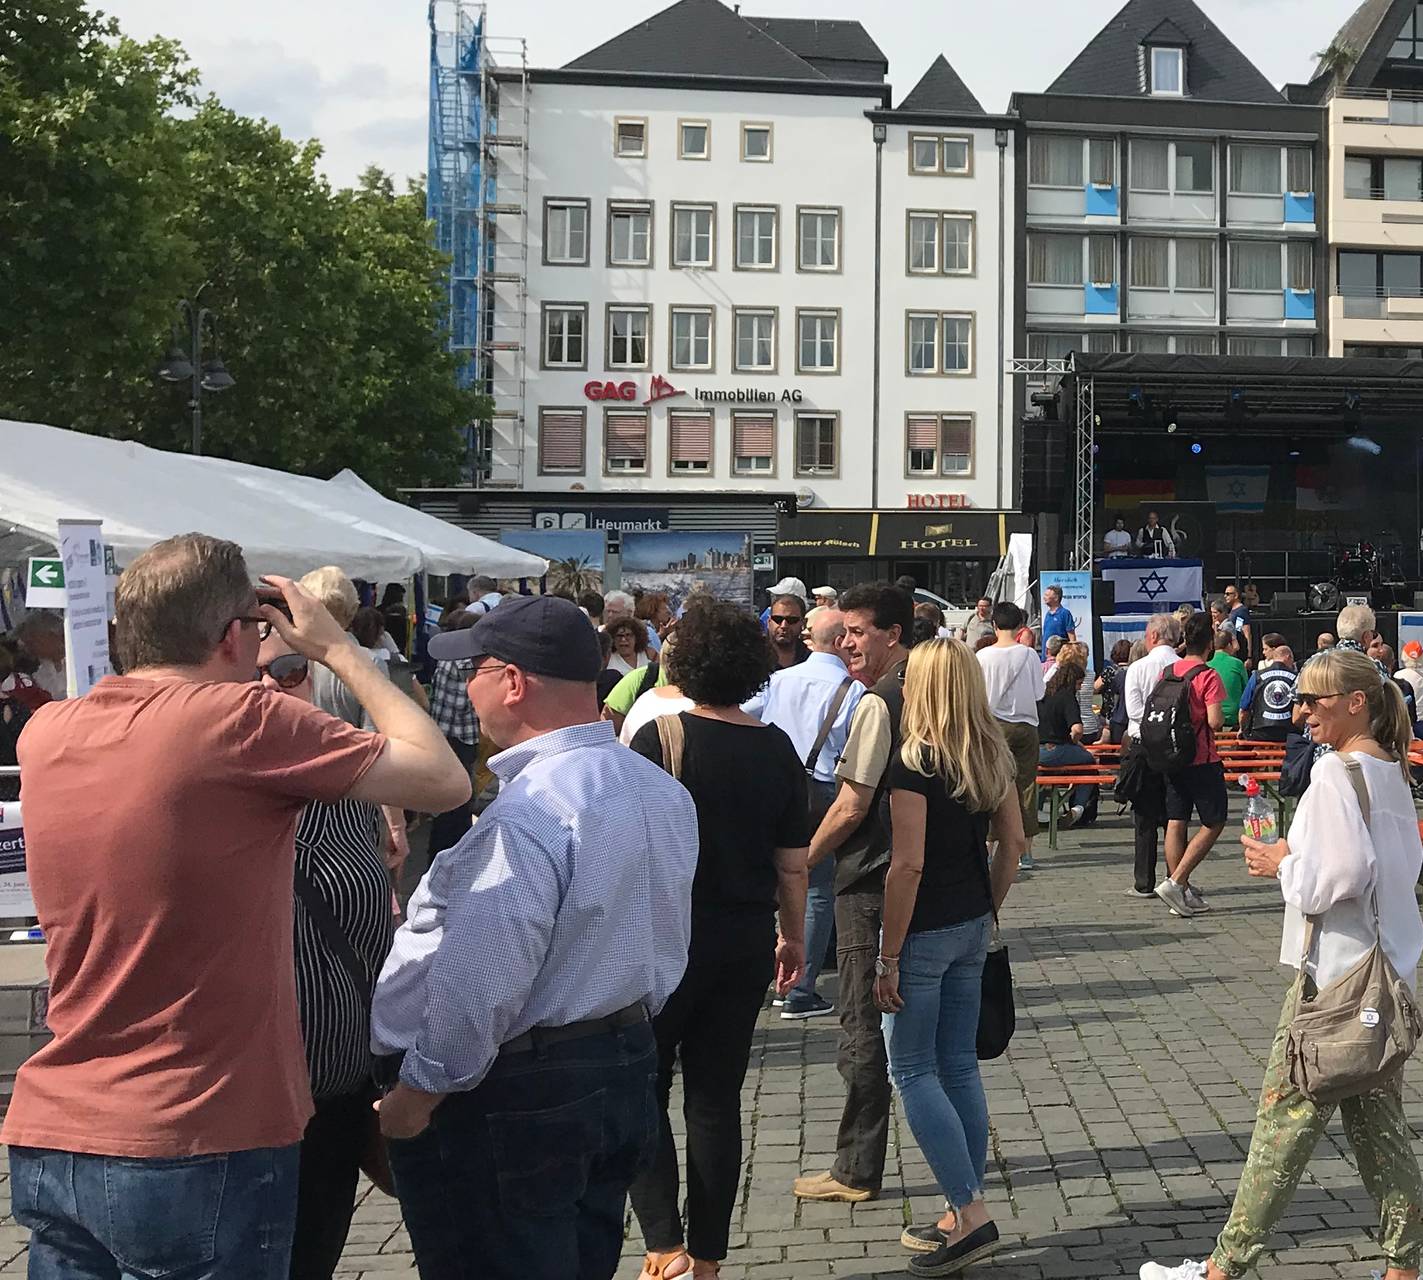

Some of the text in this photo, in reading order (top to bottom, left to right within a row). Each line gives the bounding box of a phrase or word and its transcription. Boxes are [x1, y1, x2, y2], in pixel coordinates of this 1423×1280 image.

[584, 381, 637, 401] GAG
[695, 387, 803, 402] Immobilien AG
[906, 494, 971, 508] HOTEL
[595, 518, 662, 530] Heumarkt
[900, 538, 978, 549] HOTEL
